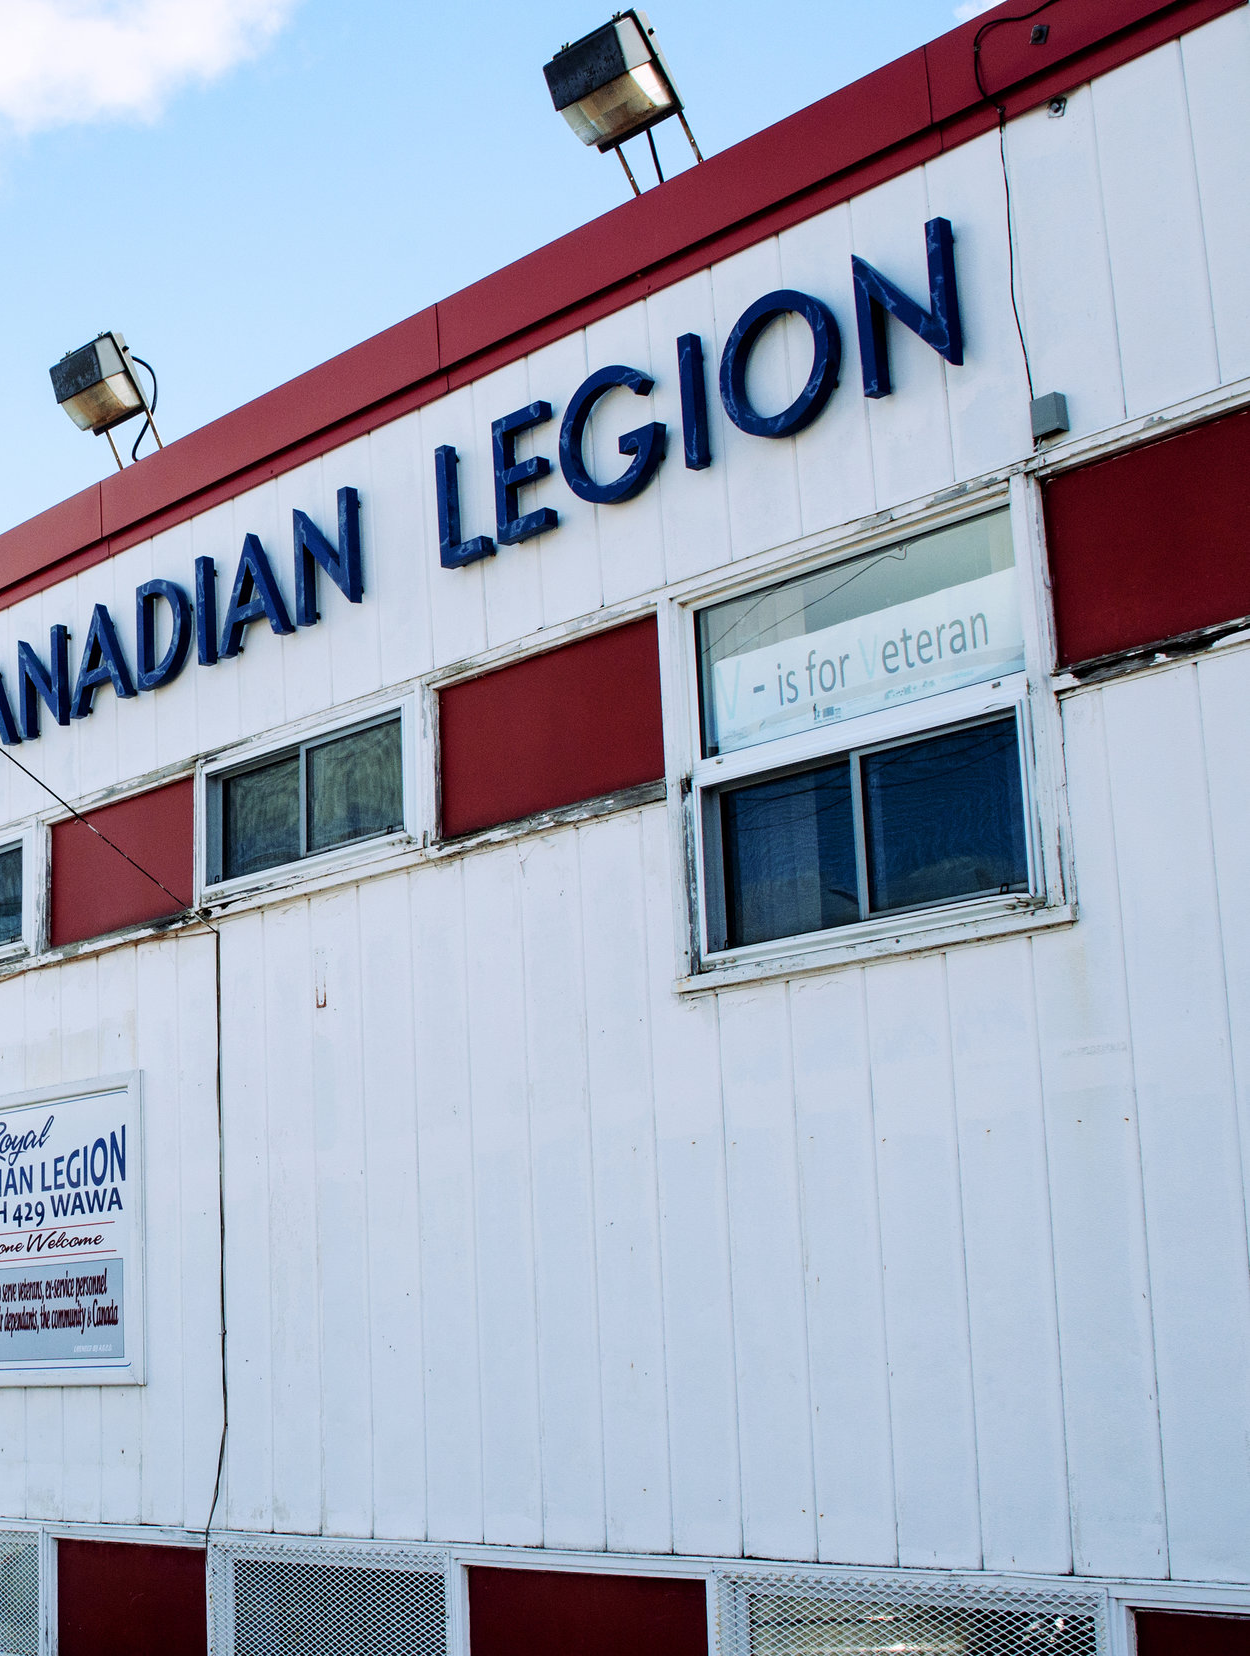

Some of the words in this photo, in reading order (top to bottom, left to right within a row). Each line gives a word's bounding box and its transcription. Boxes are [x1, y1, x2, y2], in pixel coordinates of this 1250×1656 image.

[434, 216, 964, 570] LEGION
[716, 660, 741, 720] V
[778, 662, 799, 706] is
[805, 650, 850, 697] for
[858, 612, 989, 680] Veteran
[41, 1124, 126, 1192] LEGION
[13, 1201, 45, 1228] 429
[50, 1187, 123, 1218] WAWA
[26, 1230, 104, 1253] Welcome
[1, 1285, 17, 1302] serve
[18, 1279, 44, 1304] veterans,
[44, 1270, 74, 1299] ex-service
[75, 1267, 108, 1304] personnel
[40, 1303, 50, 1331] the
[51, 1299, 86, 1335] community
[92, 1298, 119, 1327] Canada
